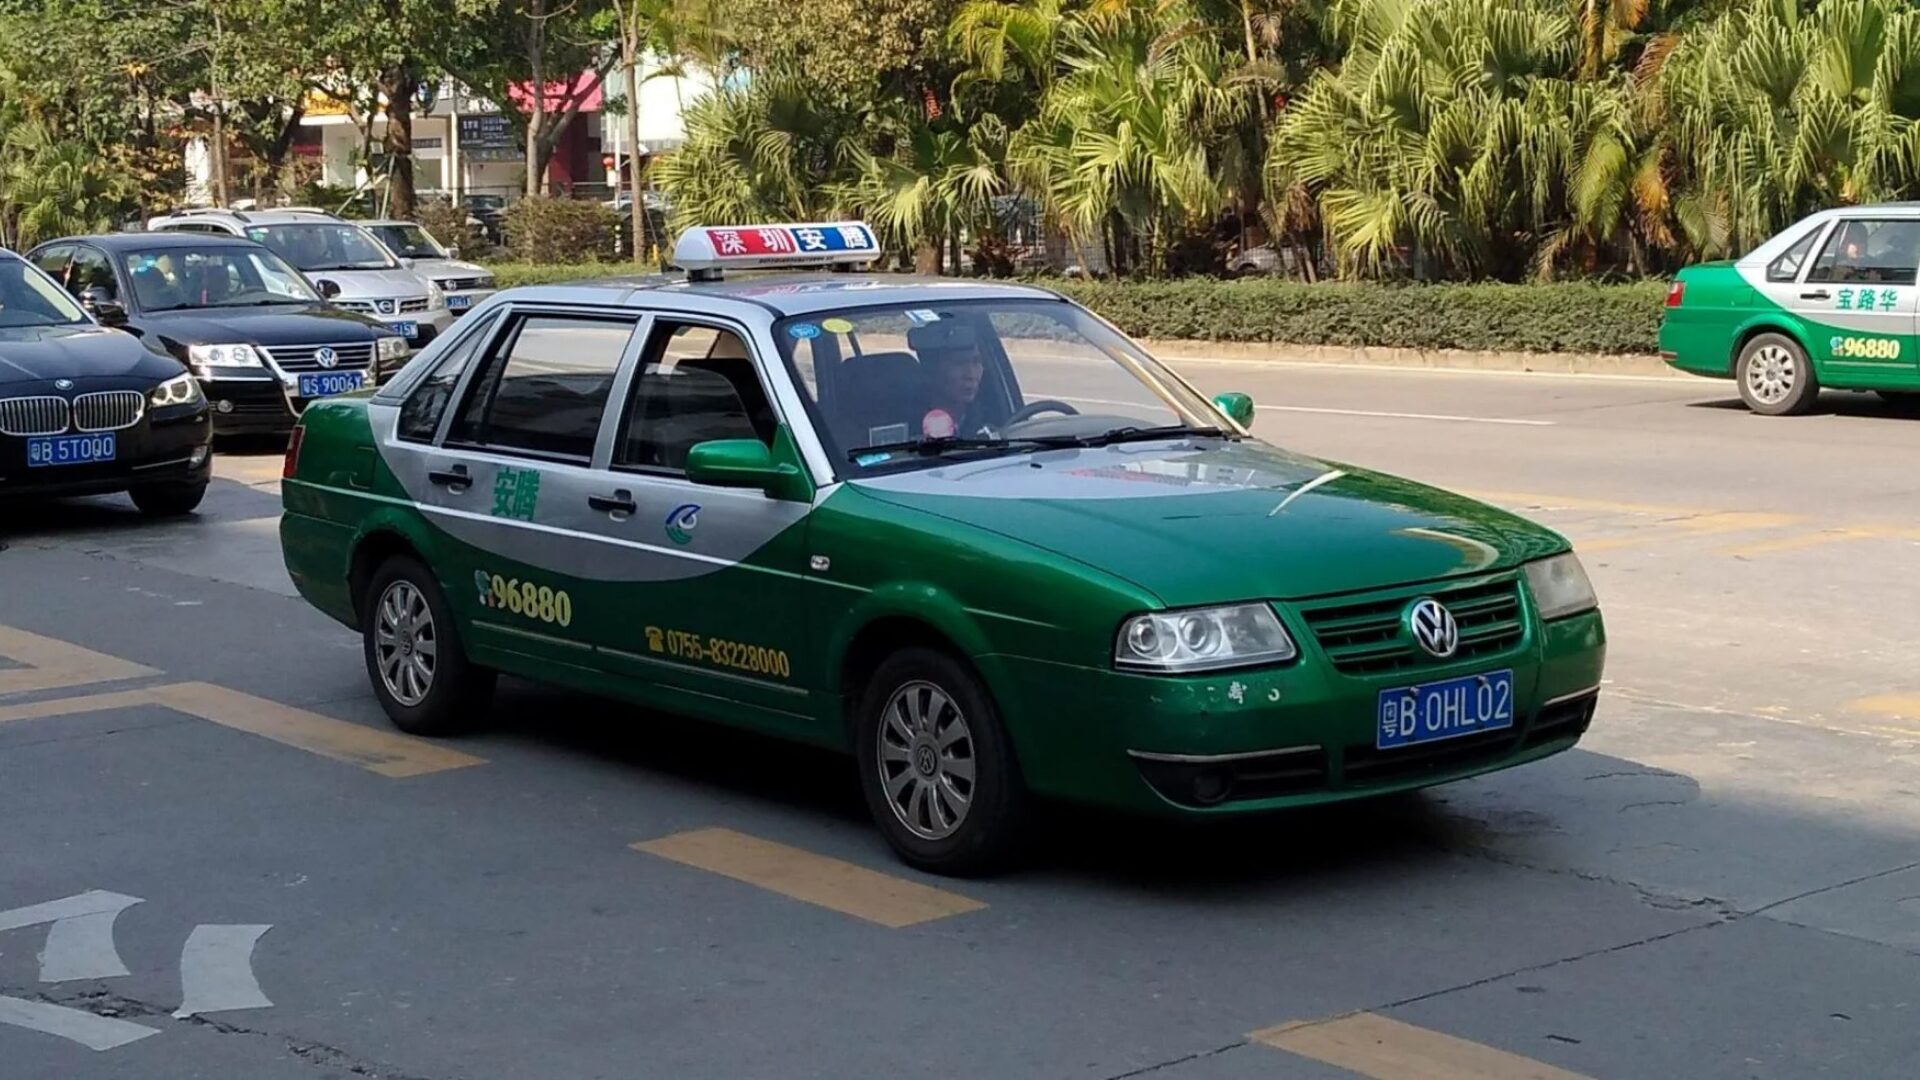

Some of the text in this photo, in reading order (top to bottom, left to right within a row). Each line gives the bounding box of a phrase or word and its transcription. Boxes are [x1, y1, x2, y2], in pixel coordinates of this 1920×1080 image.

[1835, 287, 1898, 312] 宝路华
[1844, 337, 1900, 359] 96880
[491, 466, 541, 521] 安腾
[491, 574, 572, 628] 96880
[667, 629, 791, 677] 0755-83228000
